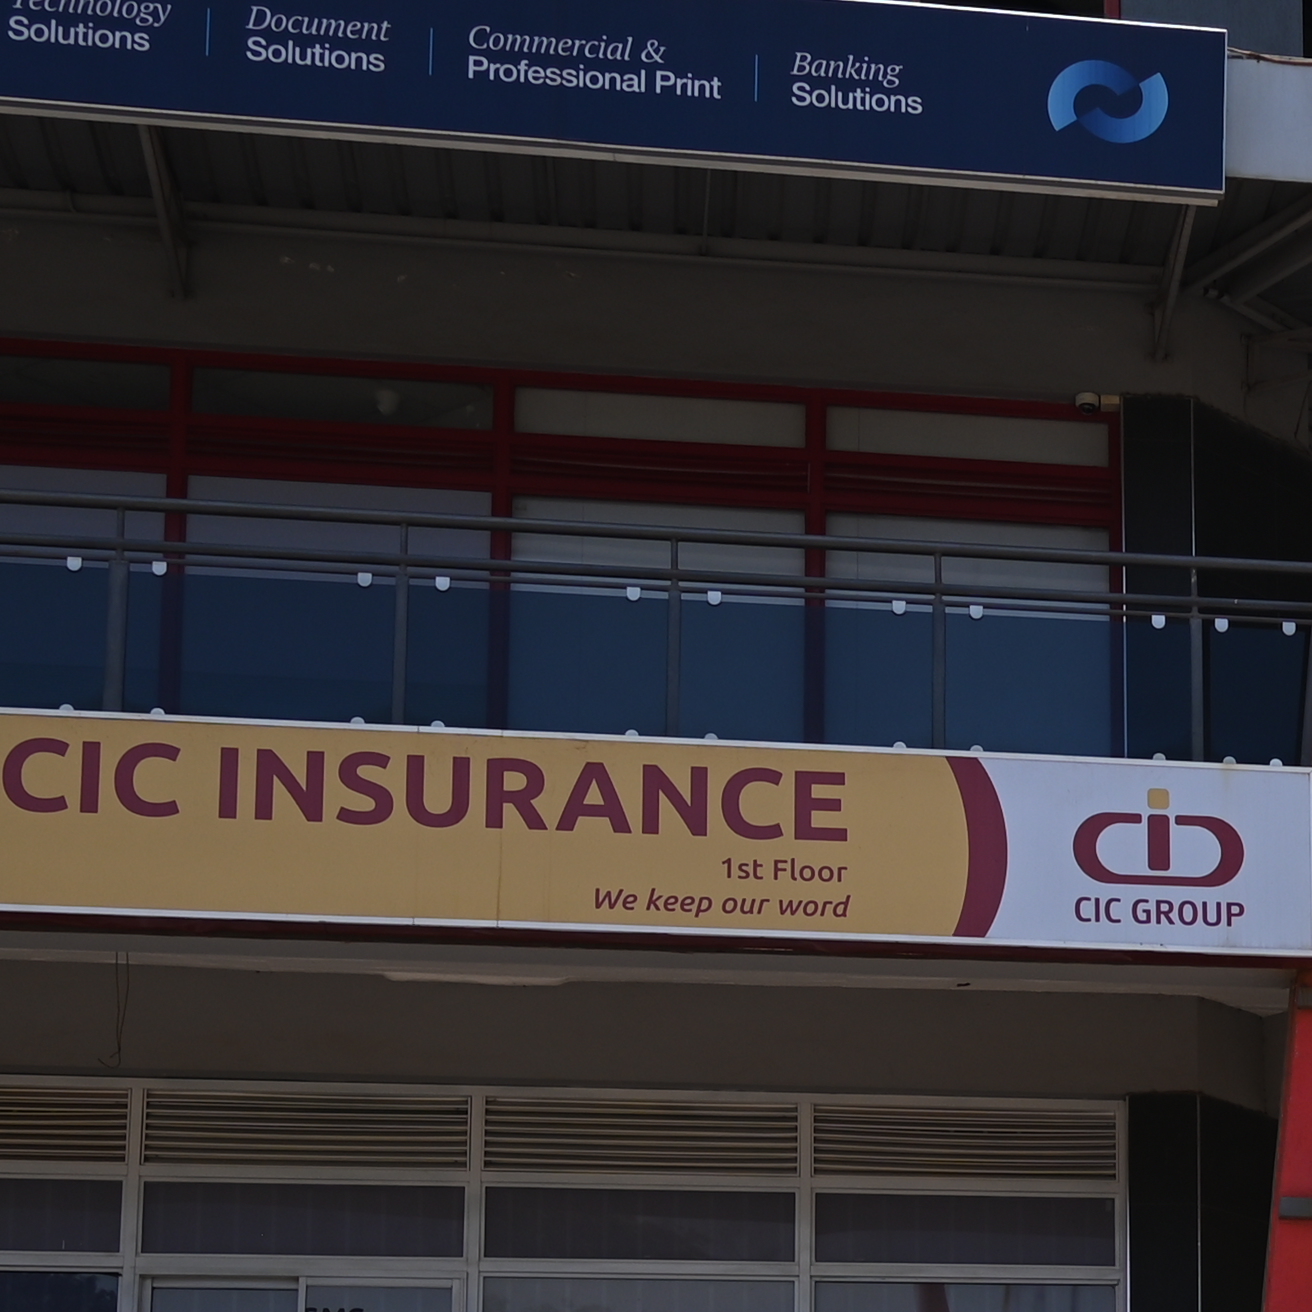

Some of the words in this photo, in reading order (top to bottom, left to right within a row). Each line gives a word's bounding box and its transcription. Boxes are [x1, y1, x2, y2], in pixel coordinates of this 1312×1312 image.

[7, 15, 150, 52] Solutions
[245, 5, 391, 41] Document
[245, 36, 386, 72] Solutions
[467, 24, 633, 61] Commercial
[641, 38, 666, 64] &
[467, 55, 645, 94] Professional
[655, 70, 721, 100] Print
[790, 51, 902, 88] Banking
[791, 82, 923, 115] Solutions
[2, 737, 181, 818] CIC
[218, 746, 848, 843] INSURANCE
[721, 857, 764, 881] 1st
[773, 859, 848, 883] Floor
[594, 887, 639, 912] We
[645, 887, 713, 919] keep
[721, 893, 770, 916] our
[777, 894, 851, 919] word
[1073, 896, 1122, 924] CIC
[1130, 898, 1246, 928] GROUP
